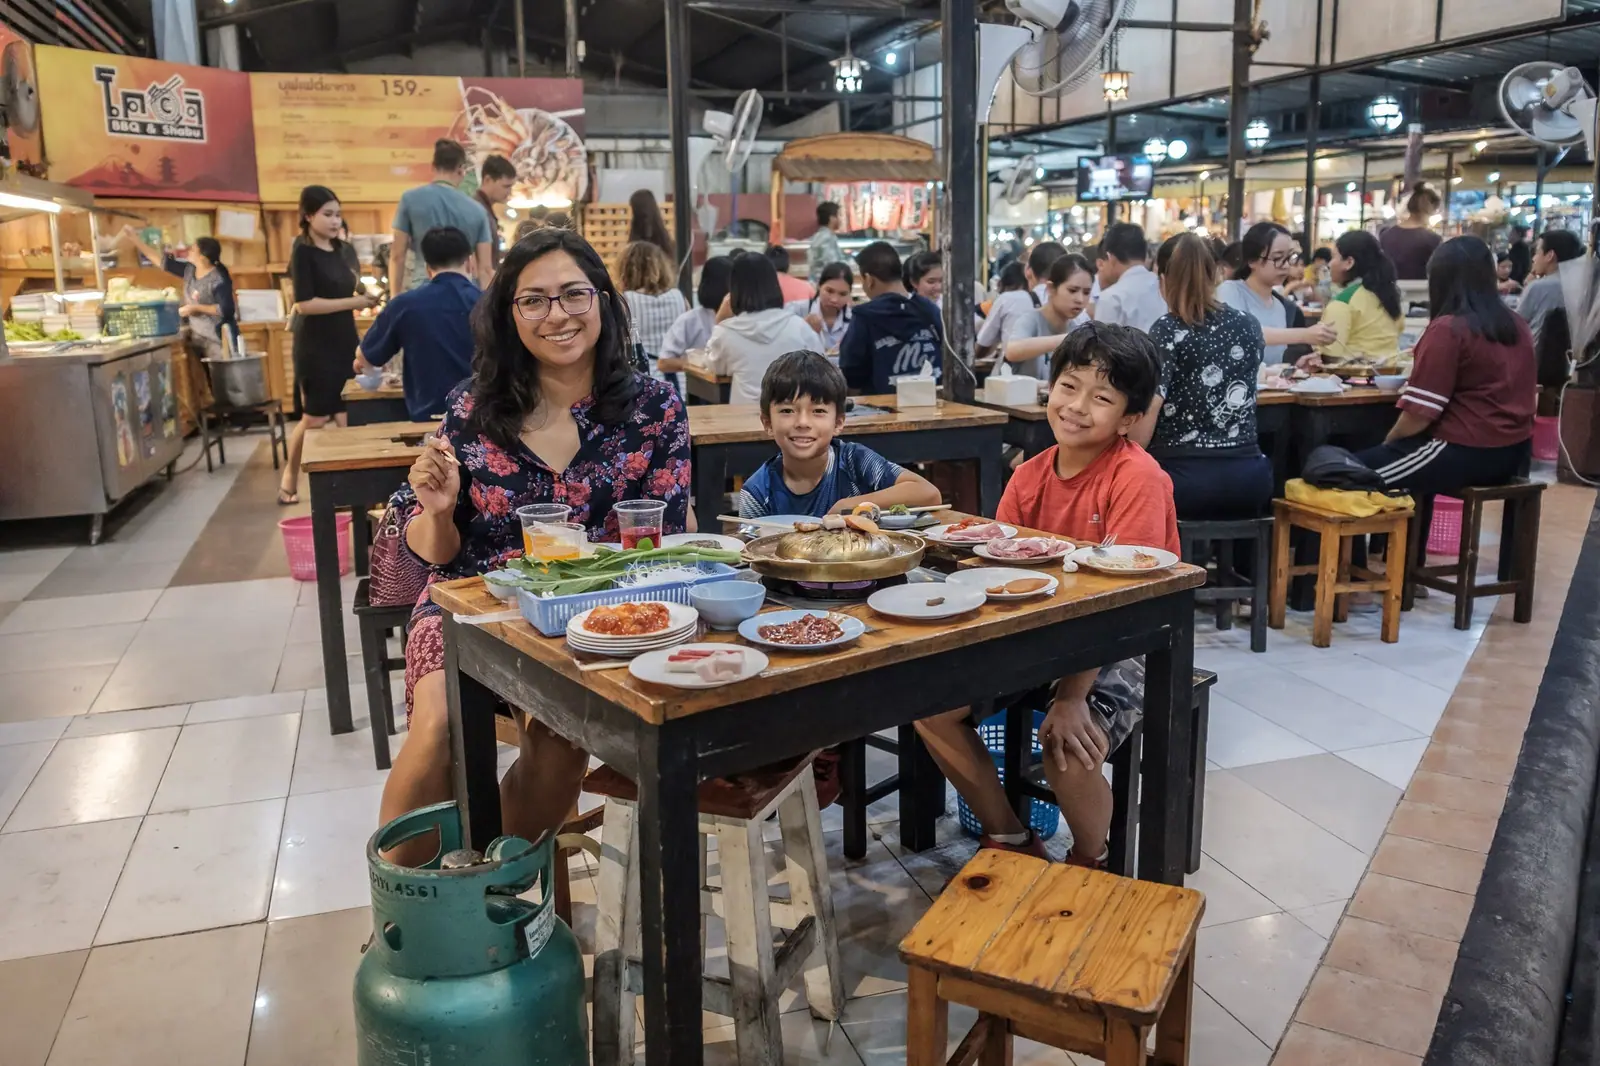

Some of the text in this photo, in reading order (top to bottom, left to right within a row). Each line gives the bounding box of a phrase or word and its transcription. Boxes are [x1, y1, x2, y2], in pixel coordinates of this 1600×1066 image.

[381, 79, 432, 97] 159.-
[111, 119, 201, 138] BBQ & Shabu
